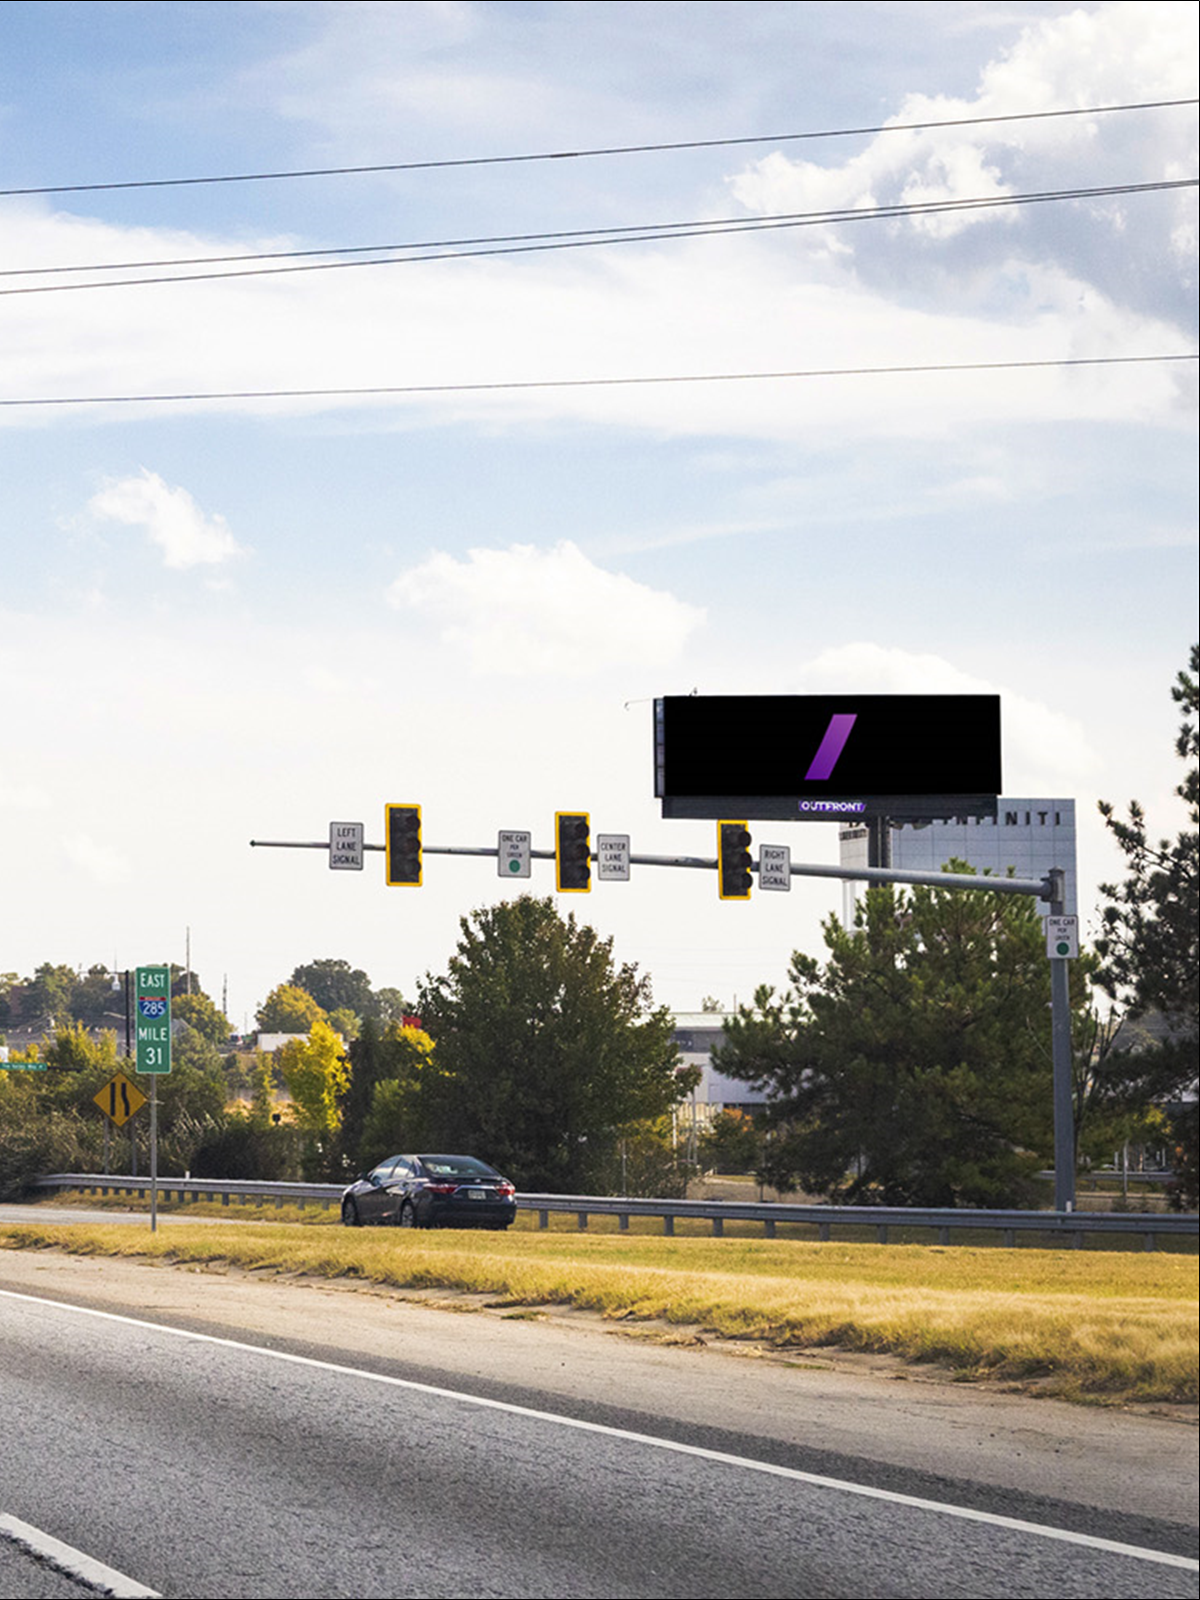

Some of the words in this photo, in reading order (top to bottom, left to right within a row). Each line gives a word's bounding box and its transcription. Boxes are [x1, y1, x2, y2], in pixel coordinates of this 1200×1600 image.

[801, 800, 862, 812] OUTFRONT
[337, 827, 356, 838] LEFT
[501, 834, 514, 843] ONE
[515, 834, 527, 843] CAR
[336, 841, 357, 851] LANE
[600, 841, 626, 851] CENTER
[332, 854, 360, 866] SIGNAL
[604, 853, 622, 862] LANE
[764, 849, 785, 860] RIGHT
[601, 864, 626, 873] SIGNAL
[765, 862, 784, 873] LANE
[762, 875, 787, 887] SIGNAL
[1049, 918, 1061, 926] ONE
[1063, 918, 1075, 926] CAR
[140, 972, 165, 988] EAST
[143, 1002, 165, 1015] 285
[138, 1027, 167, 1041] MILE
[145, 1047, 162, 1065] 31
